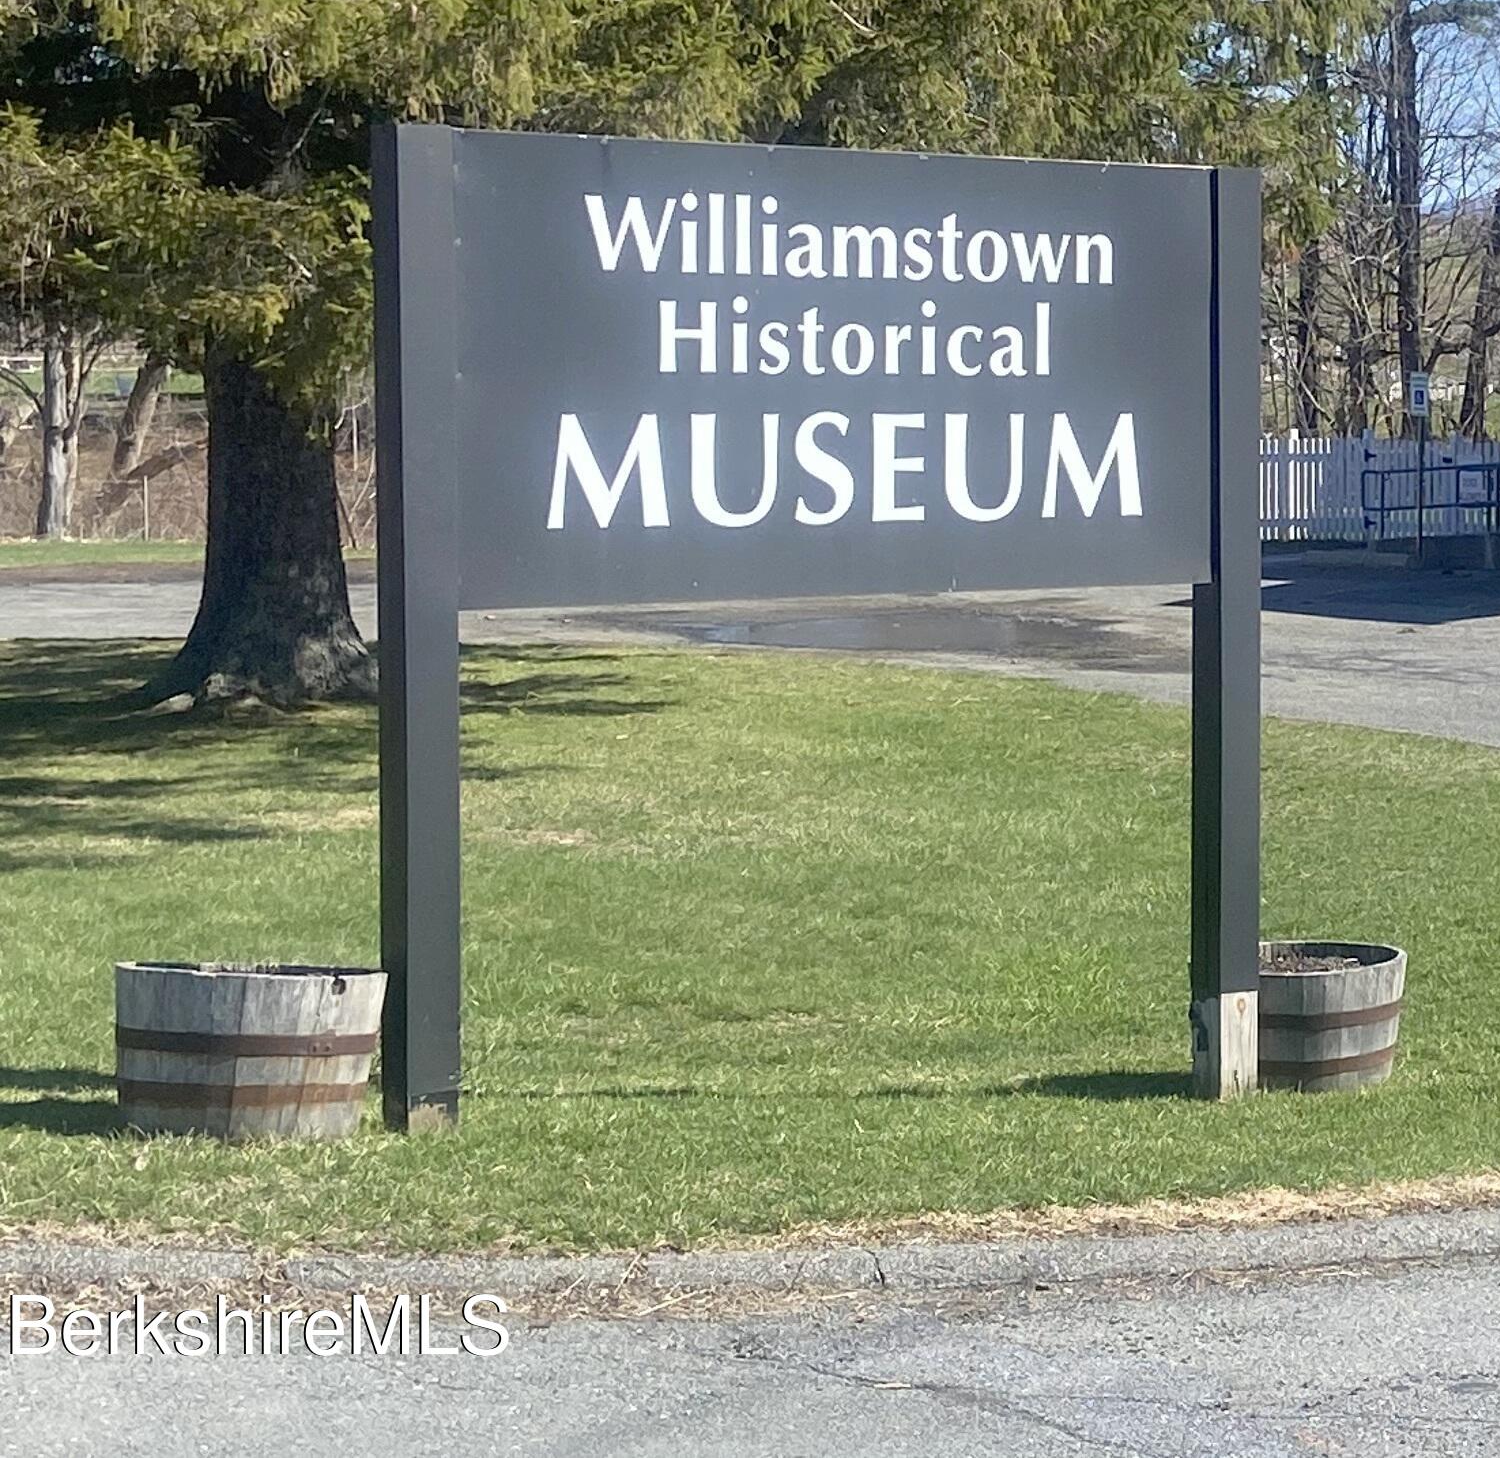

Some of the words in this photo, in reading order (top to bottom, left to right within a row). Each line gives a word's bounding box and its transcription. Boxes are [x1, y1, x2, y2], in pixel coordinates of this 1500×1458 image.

[584, 190, 1114, 285] Williamstown
[658, 295, 1052, 378] Historical
[545, 410, 1144, 531] MUSEUM
